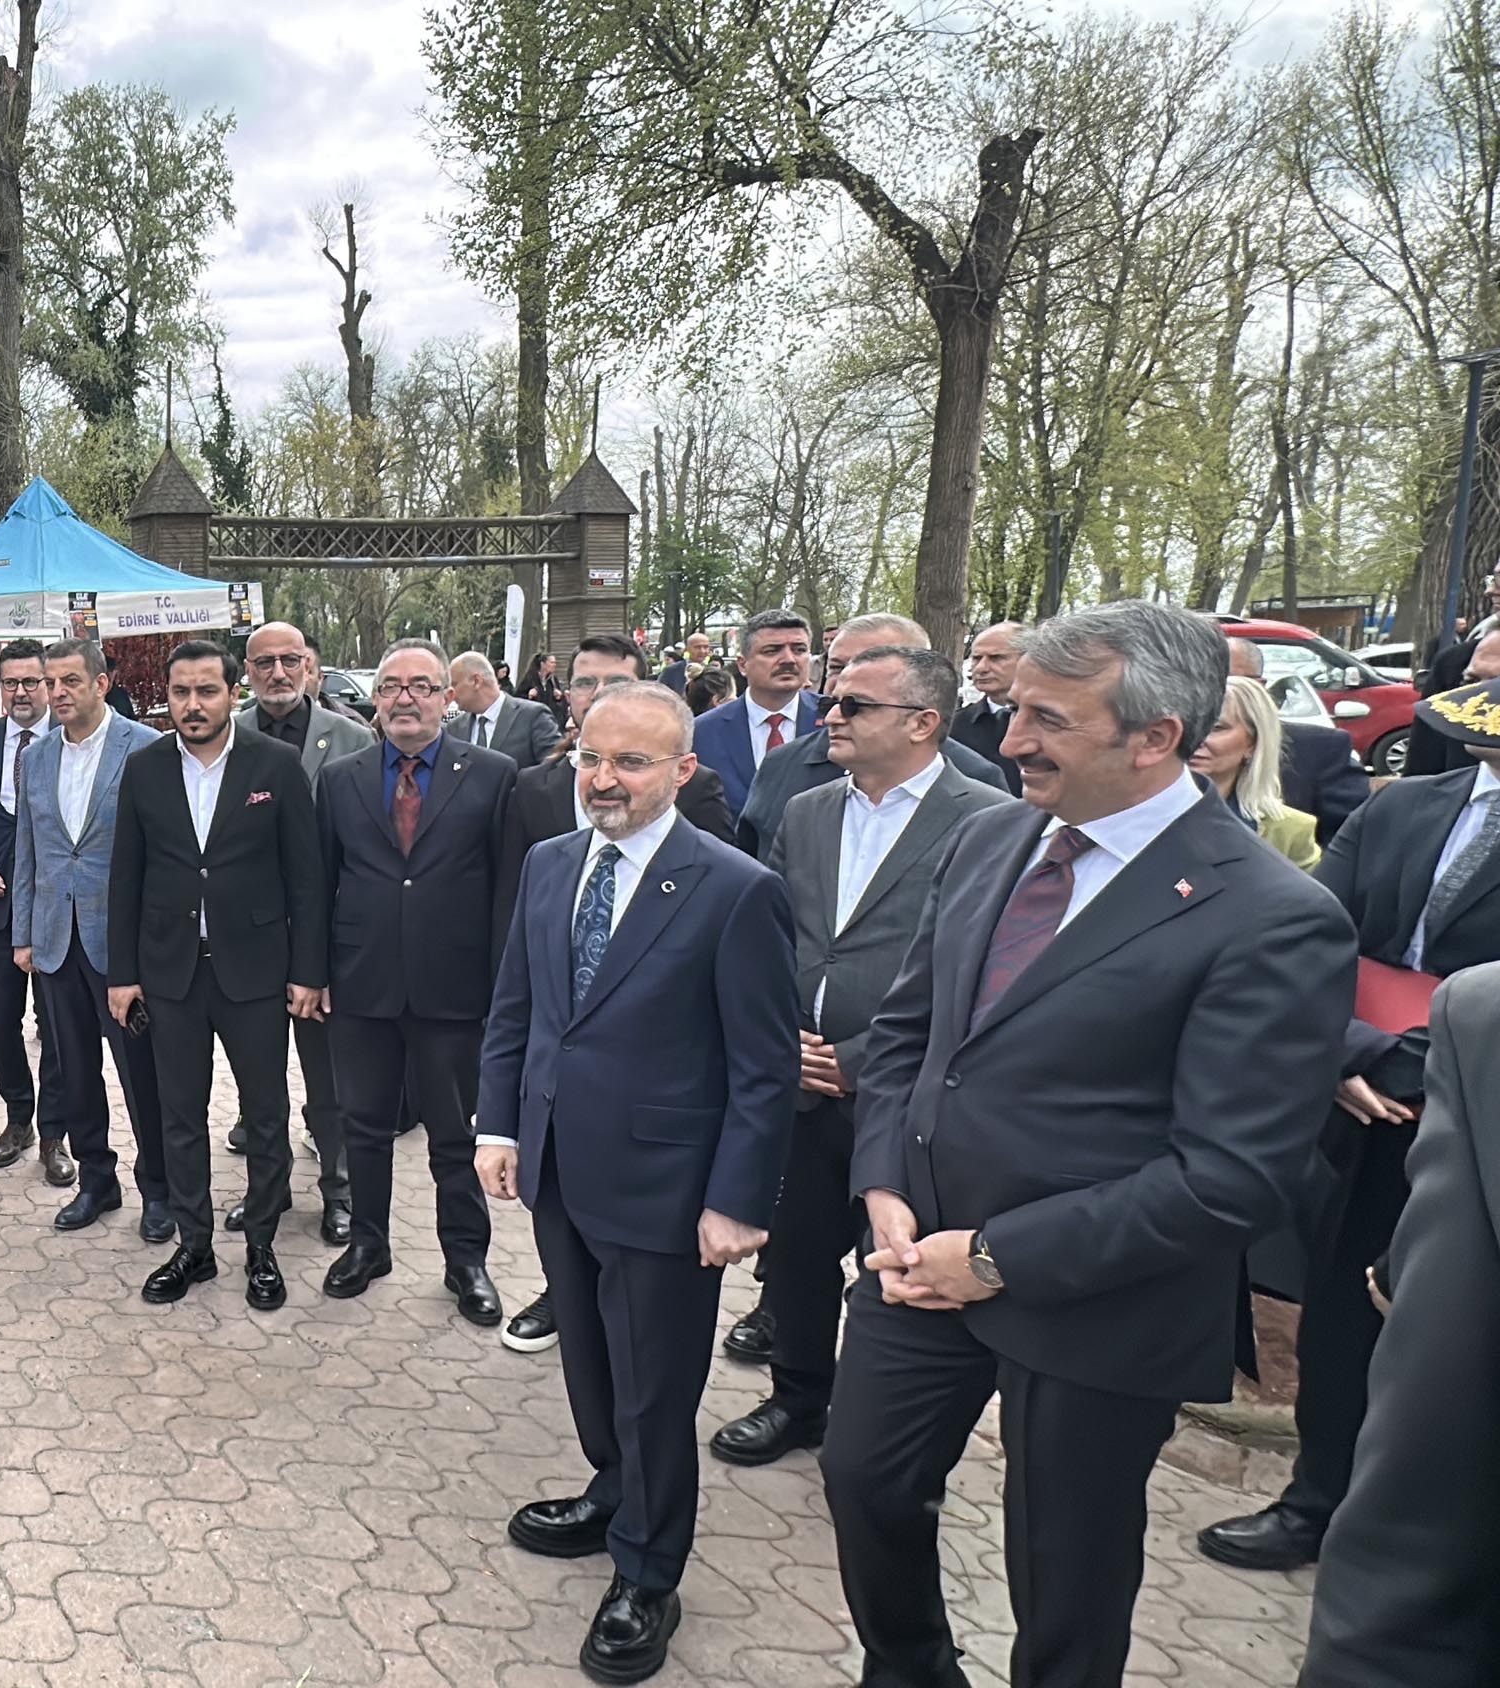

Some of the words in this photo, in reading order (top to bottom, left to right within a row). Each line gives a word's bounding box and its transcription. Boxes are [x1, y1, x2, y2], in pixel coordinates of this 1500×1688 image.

[155, 596, 175, 608] T.C.
[118, 612, 160, 628] EDİRNE
[166, 609, 210, 625] VALİLİĞİ
